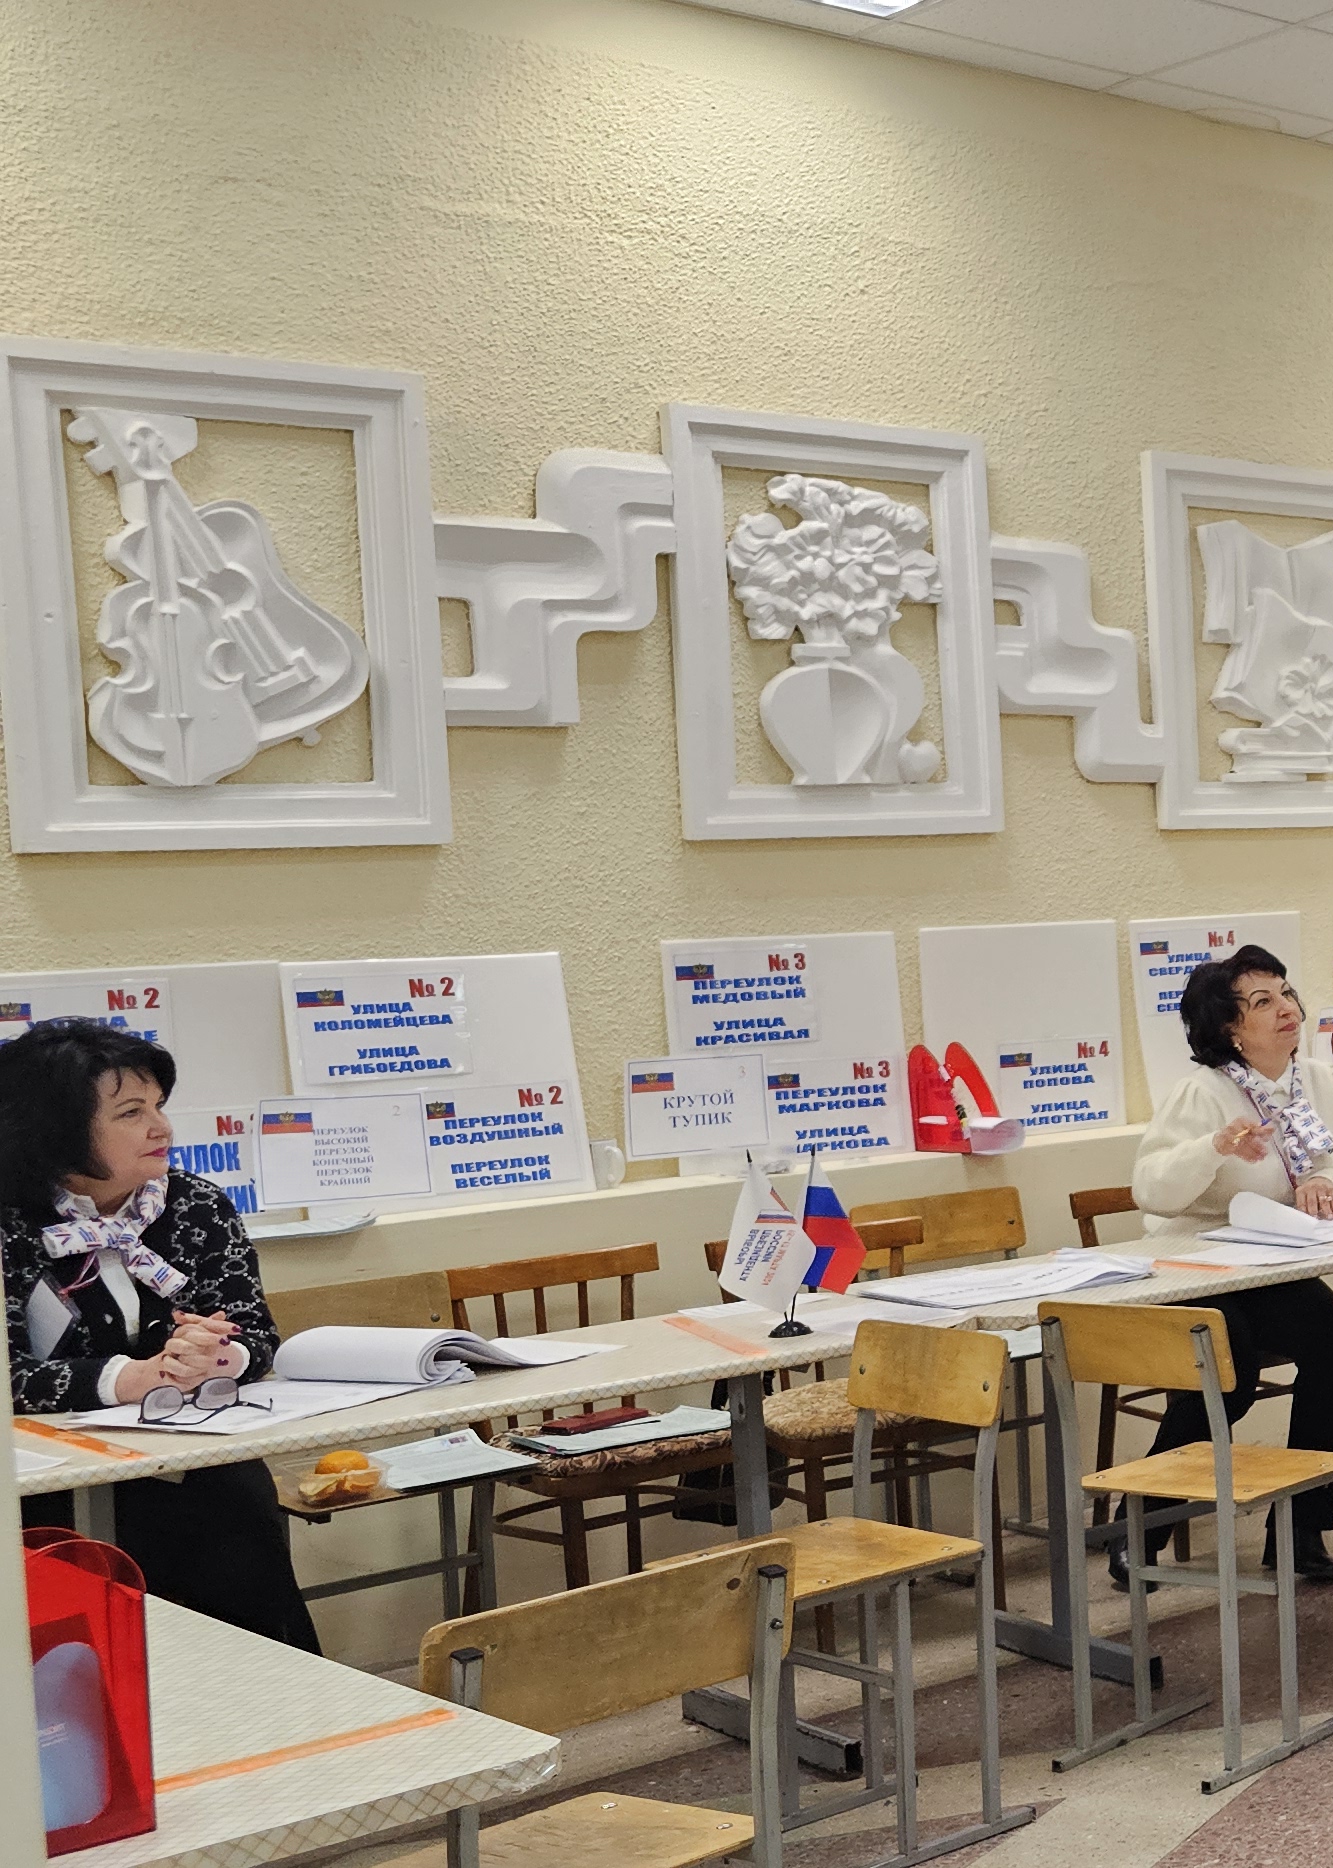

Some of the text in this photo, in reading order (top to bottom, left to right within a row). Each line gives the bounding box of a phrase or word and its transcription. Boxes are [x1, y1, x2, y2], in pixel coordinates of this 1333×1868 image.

[768, 953, 806, 972] № 3
[1167, 952, 1212, 963] УЛИЦА
[408, 977, 455, 998] № 2
[694, 975, 802, 990] ПЕРЕУЛОК
[107, 987, 160, 1011] № 2
[692, 987, 806, 1004] МЕДОВЫЙ
[351, 1002, 414, 1015] УЛИЦА
[314, 1014, 453, 1032] КОЛОМЕЙЦЕВА
[713, 1017, 786, 1031] УЛИЦА
[696, 1028, 810, 1046] КРАСИВАЯ
[357, 1045, 420, 1059] УЛИЦА
[1099, 1040, 1110, 1057] 4
[328, 1058, 452, 1076] ГРИБОЕДОВА
[853, 1060, 891, 1080] № 3
[1029, 1063, 1088, 1076] УЛИЦА
[1023, 1075, 1095, 1089] ПОПОВА
[518, 1085, 563, 1108] № 2
[663, 1089, 735, 1109] КРУТОЙ
[776, 1083, 887, 1101] ПЕРЕУЛОК
[392, 1105, 401, 1116] 2
[778, 1097, 887, 1114] МАРКОВА
[1031, 1100, 1091, 1114] УЛИЦА
[444, 1111, 543, 1130] ПЕРЕУЛОК
[669, 1111, 732, 1128] ТУПИК
[313, 1126, 368, 1135] ПЕРЕУЛОК
[429, 1123, 564, 1146] ВОЗДУШНЫЙ
[795, 1125, 870, 1140] УЛИЦА
[315, 1135, 368, 1146] ВЫСОКИЙ
[796, 1136, 890, 1153] АРКОВА
[315, 1146, 370, 1156] ПЕРЕУЛОК
[313, 1155, 374, 1166] КОНЕЧНЫЙ
[451, 1155, 550, 1174] ПЕРЕУЛОК
[316, 1166, 372, 1176] ПЕРЕУЛОК
[455, 1168, 551, 1189] ВЕСЕЛЫЙ
[320, 1176, 370, 1186] КРАЙНИЙ
